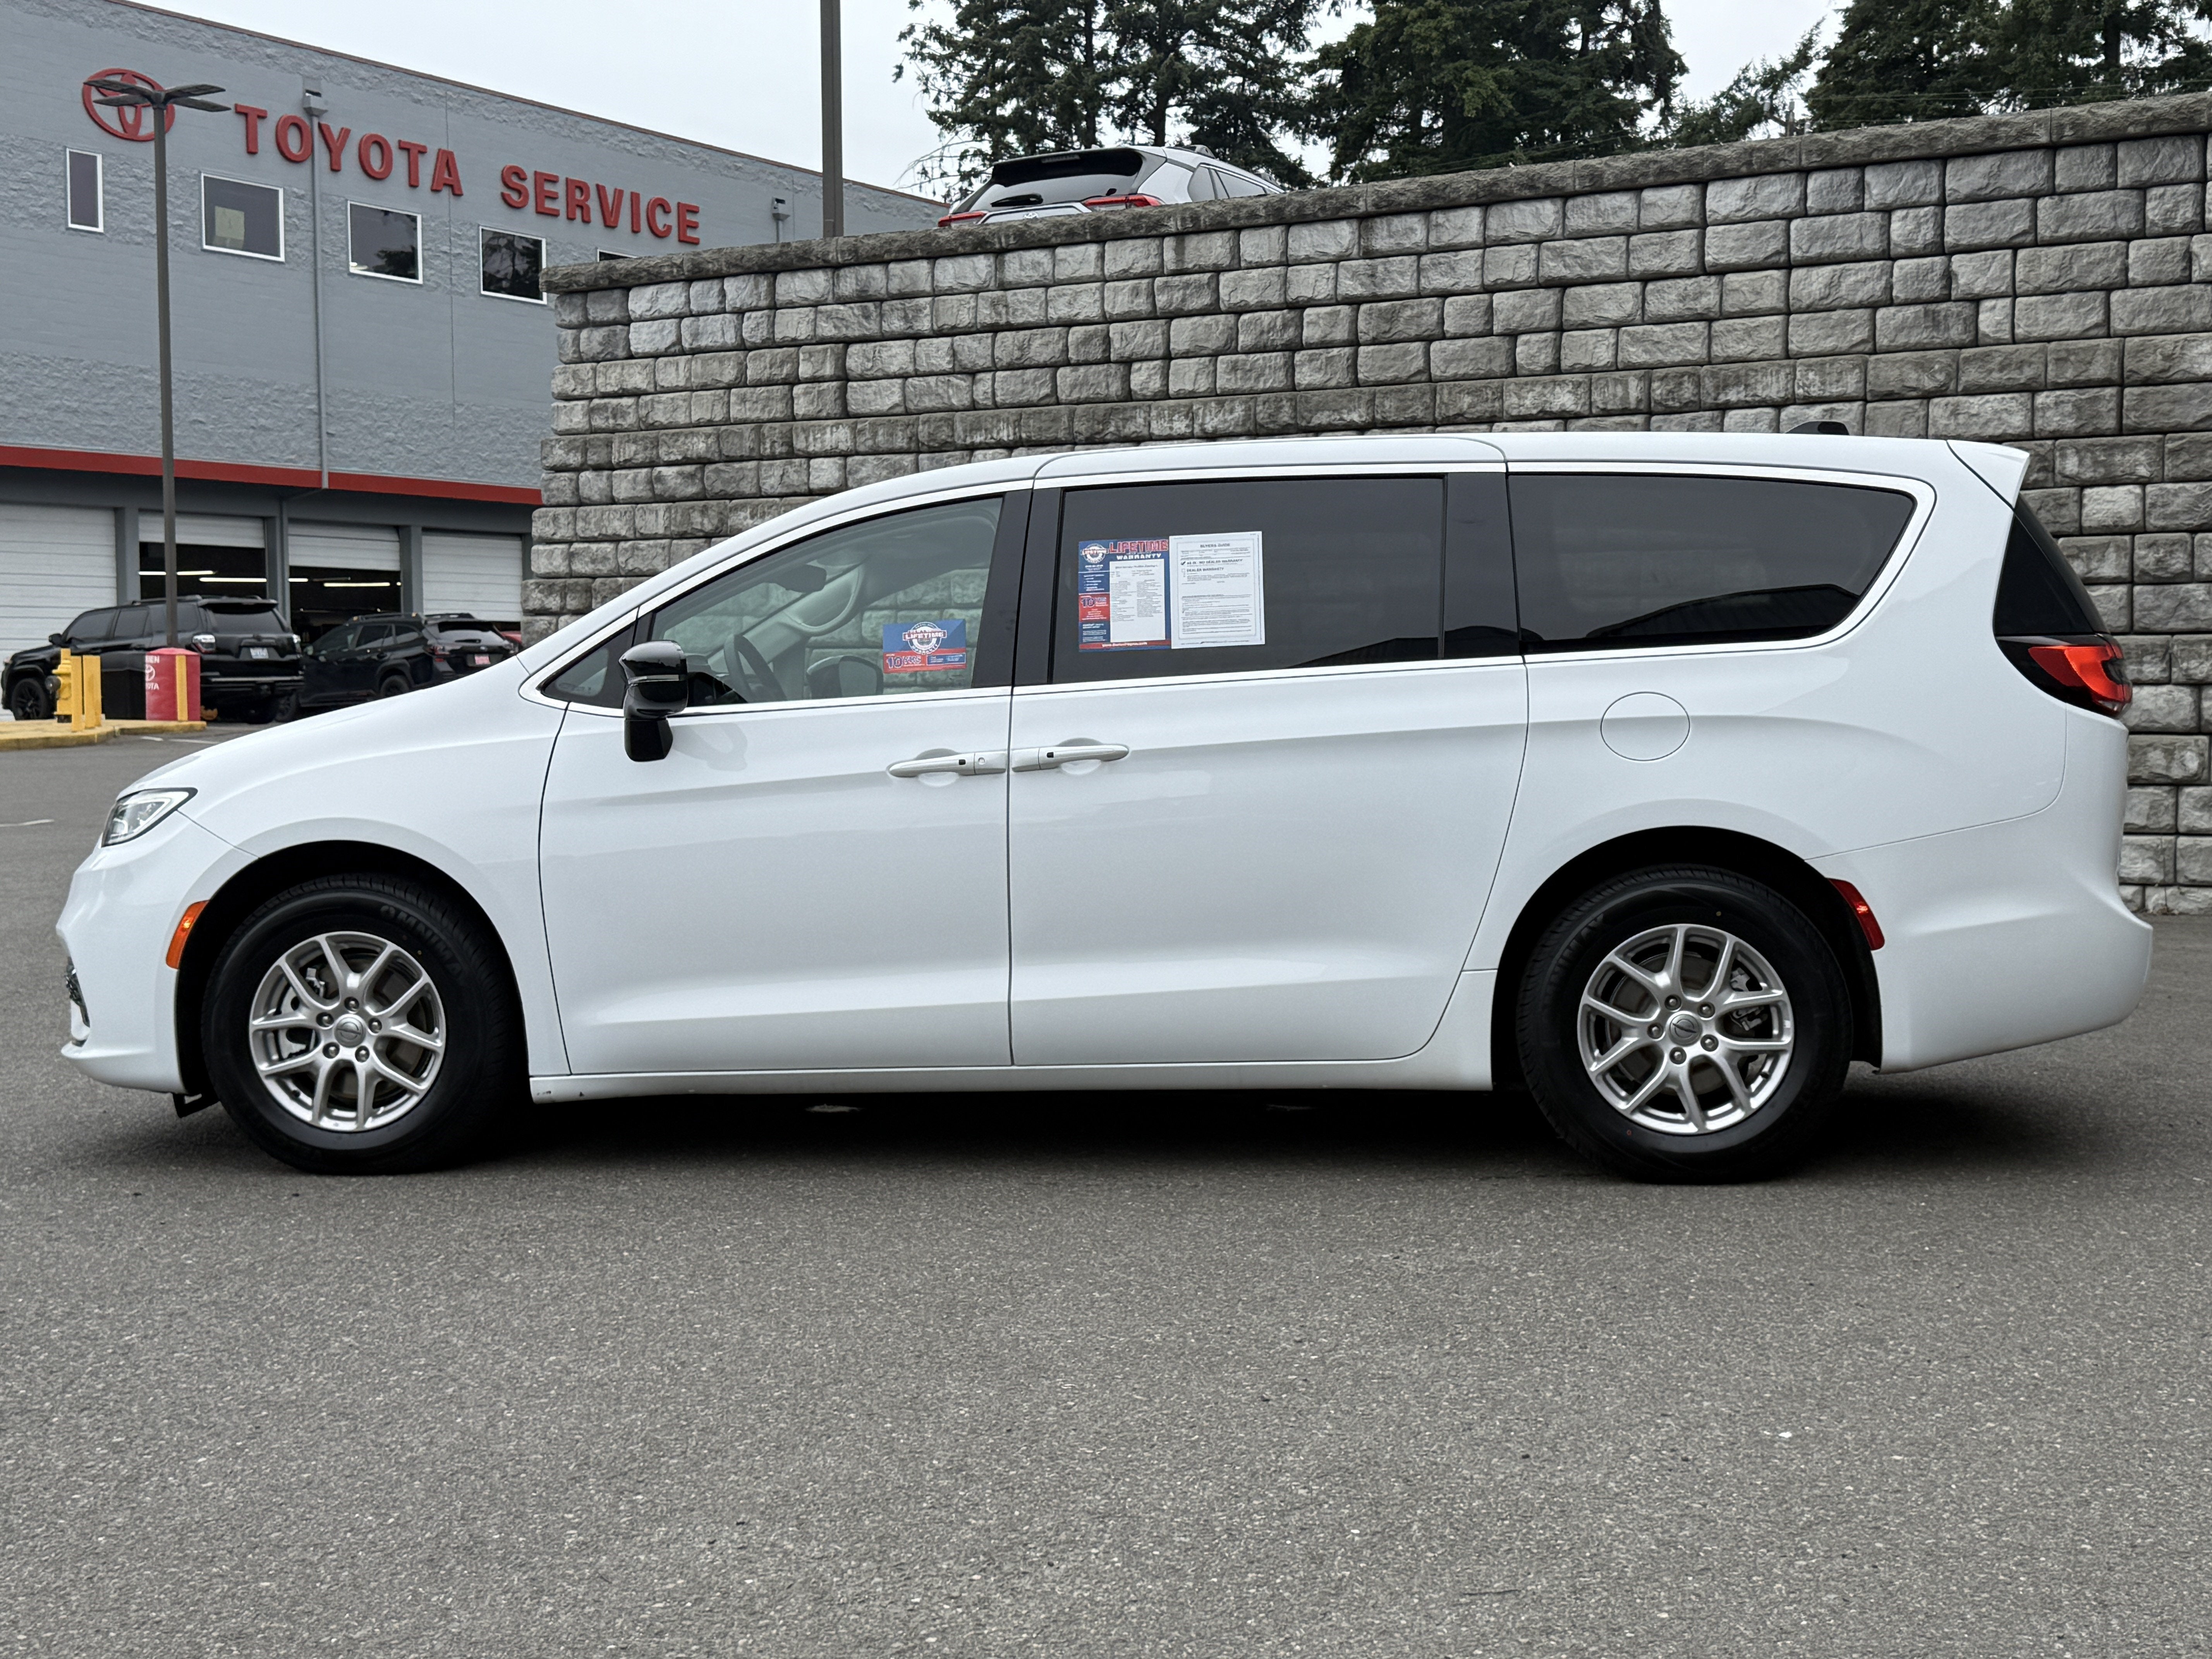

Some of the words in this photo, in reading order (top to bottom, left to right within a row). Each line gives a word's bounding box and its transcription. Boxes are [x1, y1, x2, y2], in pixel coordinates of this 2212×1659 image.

[235, 103, 463, 196] TOYOTA
[501, 164, 700, 245] SERVICE
[1109, 539, 1168, 553] LIFETIME
[886, 656, 903, 669] 10
